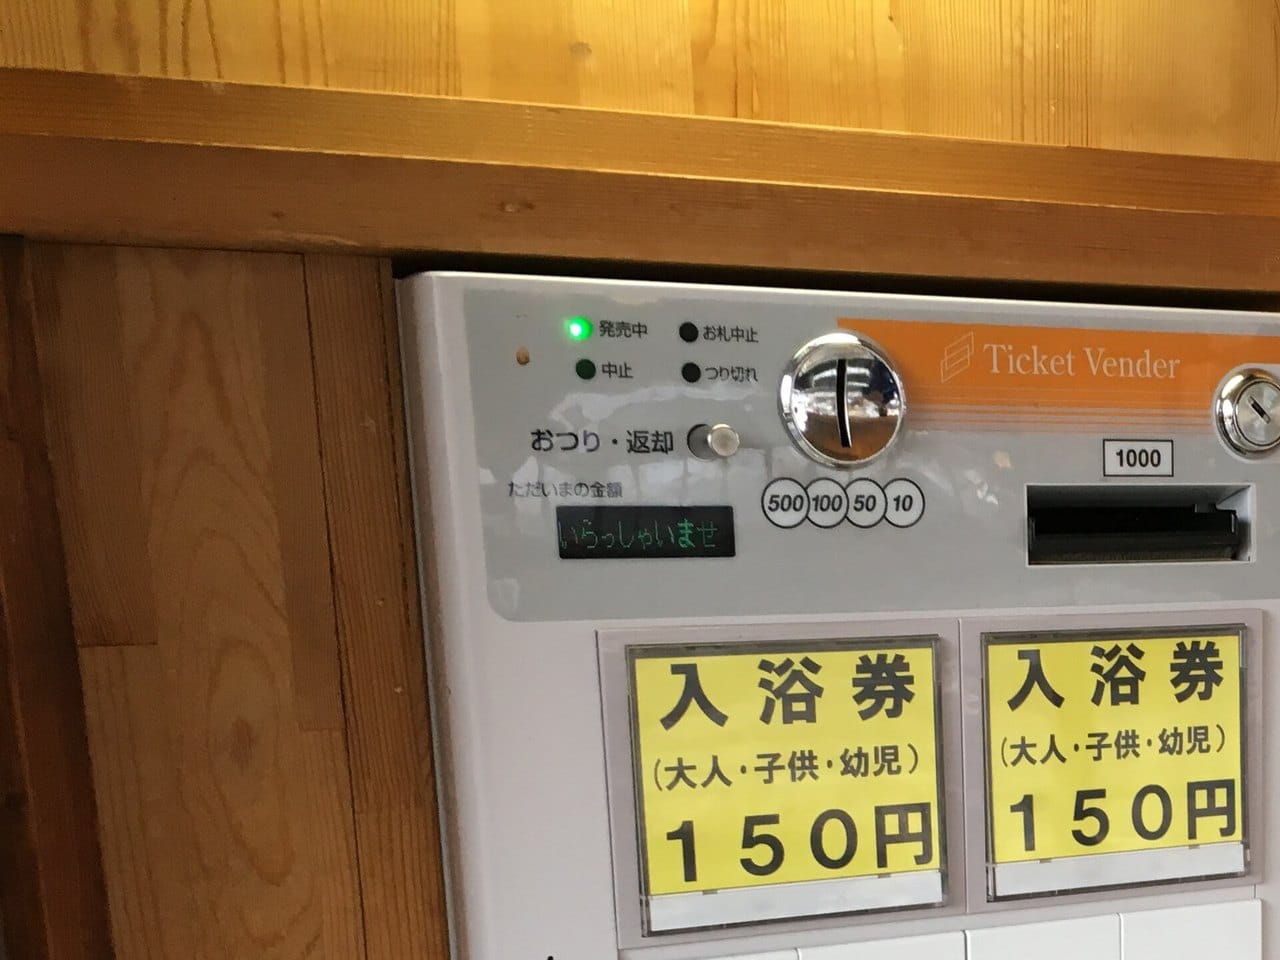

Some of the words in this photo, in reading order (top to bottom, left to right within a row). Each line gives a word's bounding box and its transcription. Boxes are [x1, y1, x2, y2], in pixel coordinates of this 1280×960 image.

[599, 320, 648, 339] 発売中
[702, 325, 759, 343] お札中止
[601, 361, 634, 378] 中止
[983, 343, 1075, 376] Ticket
[1082, 347, 1181, 380] Vender
[705, 365, 758, 382] つり切れ
[530, 429, 674, 454] おつり・返却
[1115, 449, 1162, 468] 1000
[507, 481, 623, 499] ただいまの金額
[767, 494, 804, 512] 500
[811, 494, 843, 512] 100
[853, 494, 876, 512] 50
[893, 494, 914, 512] 10
[558, 518, 718, 550] いらっしゃいませ
[1006, 640, 1225, 711] 入浴券
[659, 653, 916, 731] 入浴券
